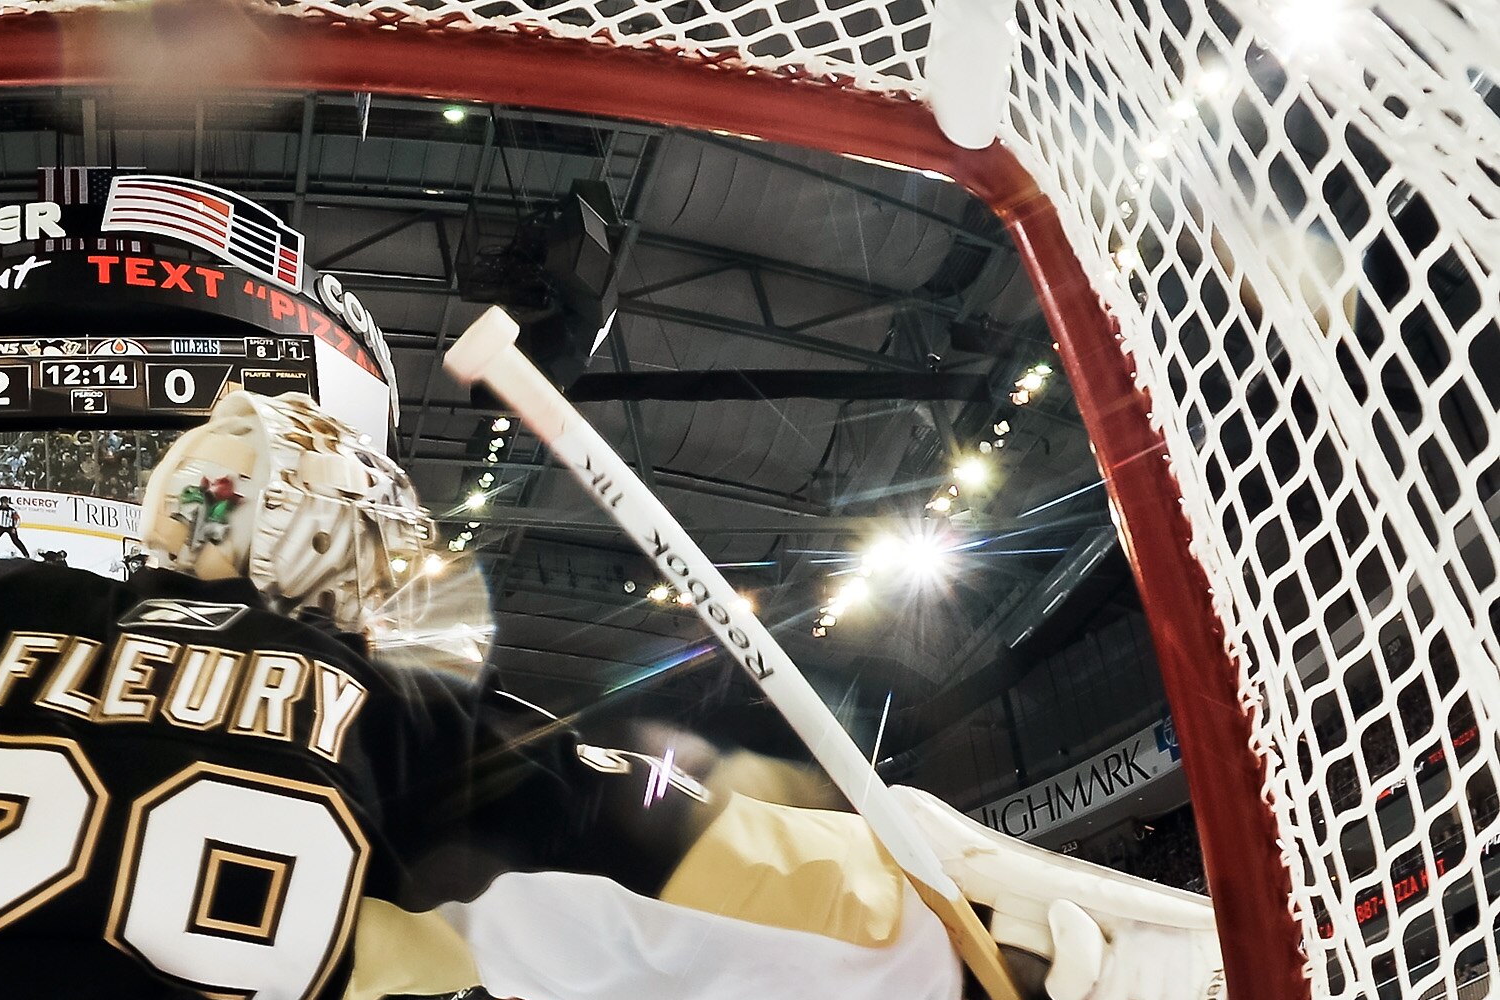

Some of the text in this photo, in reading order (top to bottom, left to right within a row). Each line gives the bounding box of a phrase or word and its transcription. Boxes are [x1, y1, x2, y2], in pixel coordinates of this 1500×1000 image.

[87, 255, 225, 299] TEXT
[256, 346, 267, 358] 8
[289, 346, 299, 359] 1
[46, 364, 129, 386] 12:14
[164, 368, 196, 404] 0
[84, 399, 95, 411] 2
[16, 496, 59, 509] ENERGY
[66, 496, 119, 528] TRIB
[647, 529, 775, 680] Reebok
[1061, 841, 1078, 854] 233
